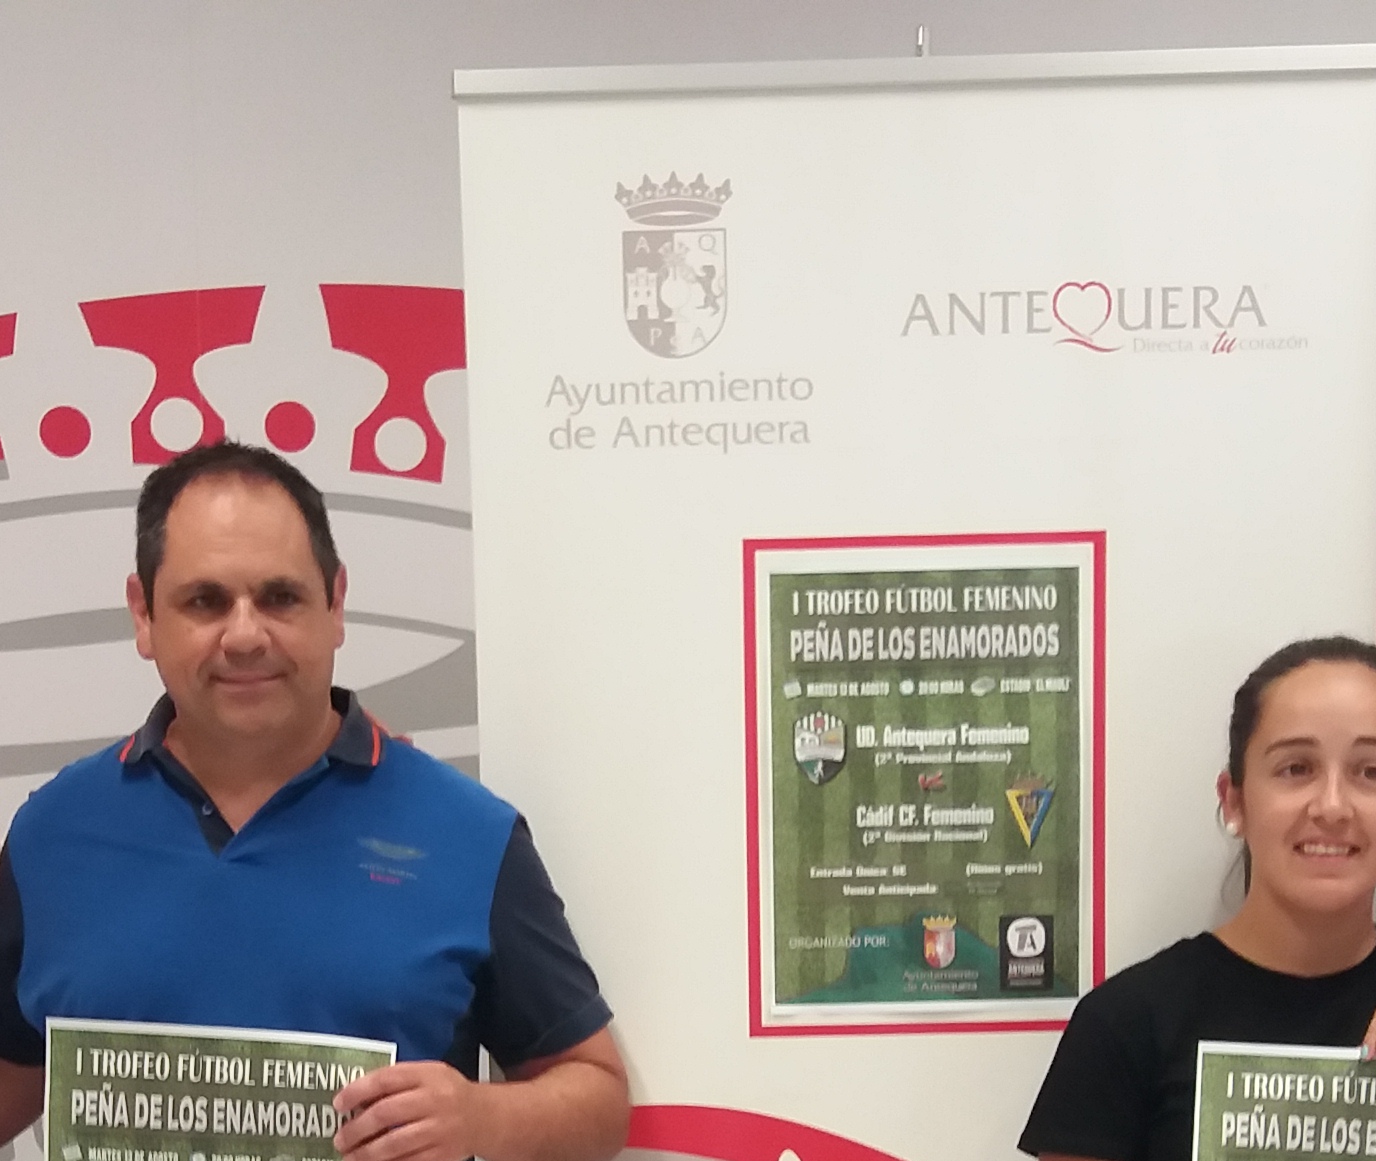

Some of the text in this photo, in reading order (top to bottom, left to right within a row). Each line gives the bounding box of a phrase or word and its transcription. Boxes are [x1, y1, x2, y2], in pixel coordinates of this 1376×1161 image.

[900, 281, 1269, 353] ANTEQUERA
[1132, 336, 1194, 354] Directa
[1199, 340, 1210, 353] a
[1238, 335, 1309, 352] corazón
[544, 370, 814, 416] Ayuntamiento
[548, 415, 811, 455] de Antequera
[792, 584, 1057, 616] I TROFEO FÚTBOL FEMENINO
[790, 620, 1060, 662] PEÑA DE LOS ENAMORADOS
[856, 722, 1030, 750] UD. Antequera Femenino
[898, 804, 919, 827] CF.
[923, 803, 995, 826] Femenino
[76, 1047, 83, 1075] I
[90, 1048, 170, 1080] TROFEO
[177, 1049, 255, 1086] FÚTBOL
[1226, 1071, 1234, 1098] I
[1241, 1072, 1324, 1102] TROFEO
[71, 1081, 352, 1138] PEÑA DE LOS ENAMORAD
[1221, 1104, 1281, 1150] PEÑA
[1286, 1114, 1316, 1152] DE
[1319, 1116, 1362, 1155] LOS
